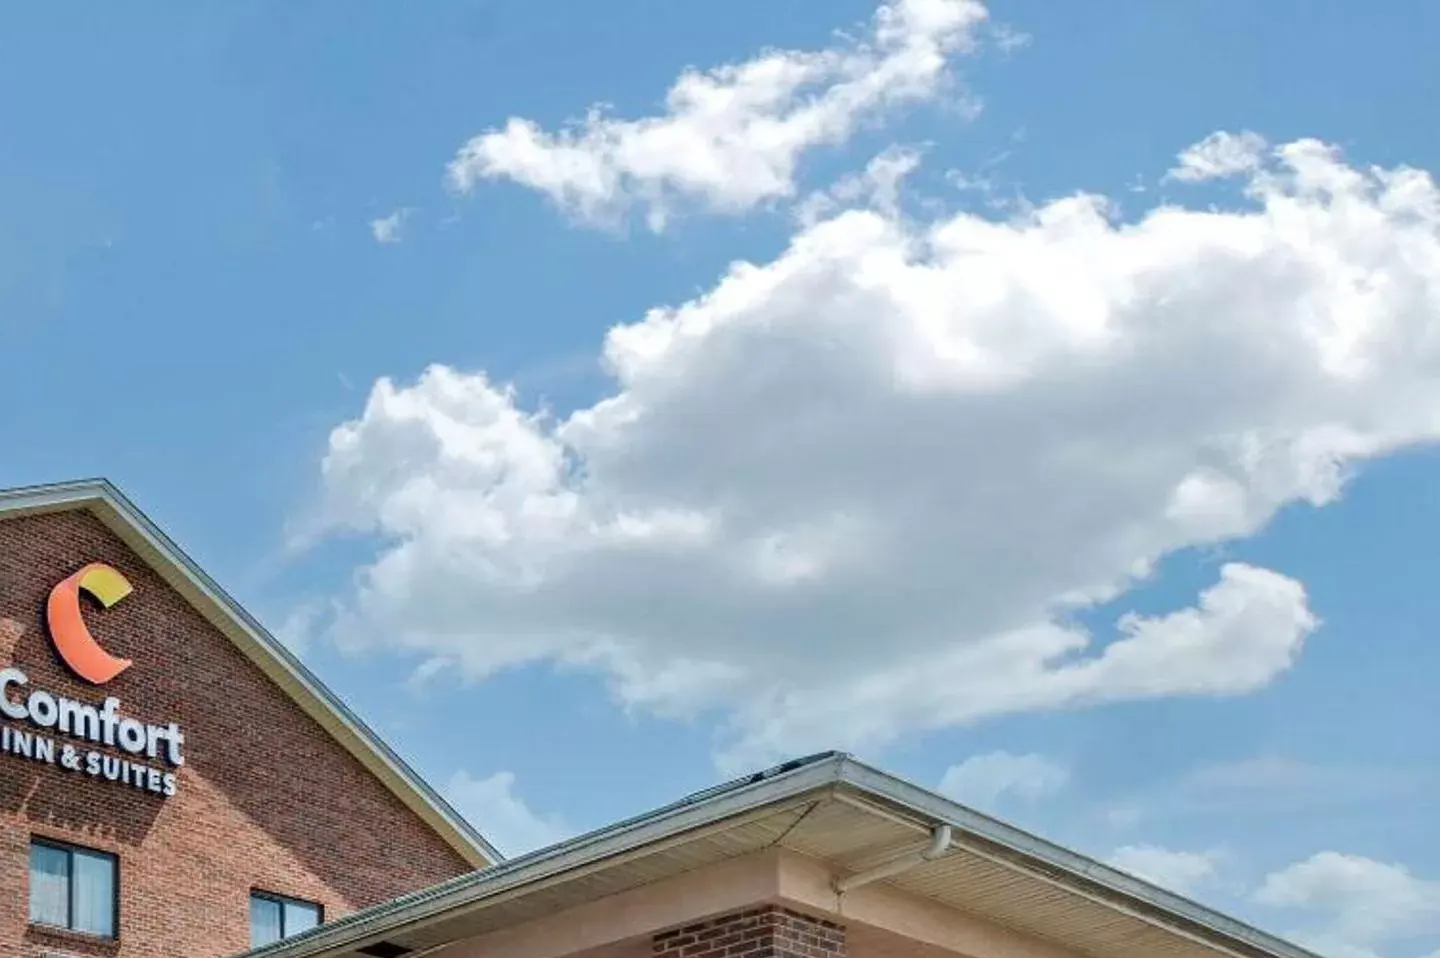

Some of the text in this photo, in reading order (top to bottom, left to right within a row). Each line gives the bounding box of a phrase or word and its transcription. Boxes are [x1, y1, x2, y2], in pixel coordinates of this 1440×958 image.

[1, 727, 177, 796] INN & SUITES
